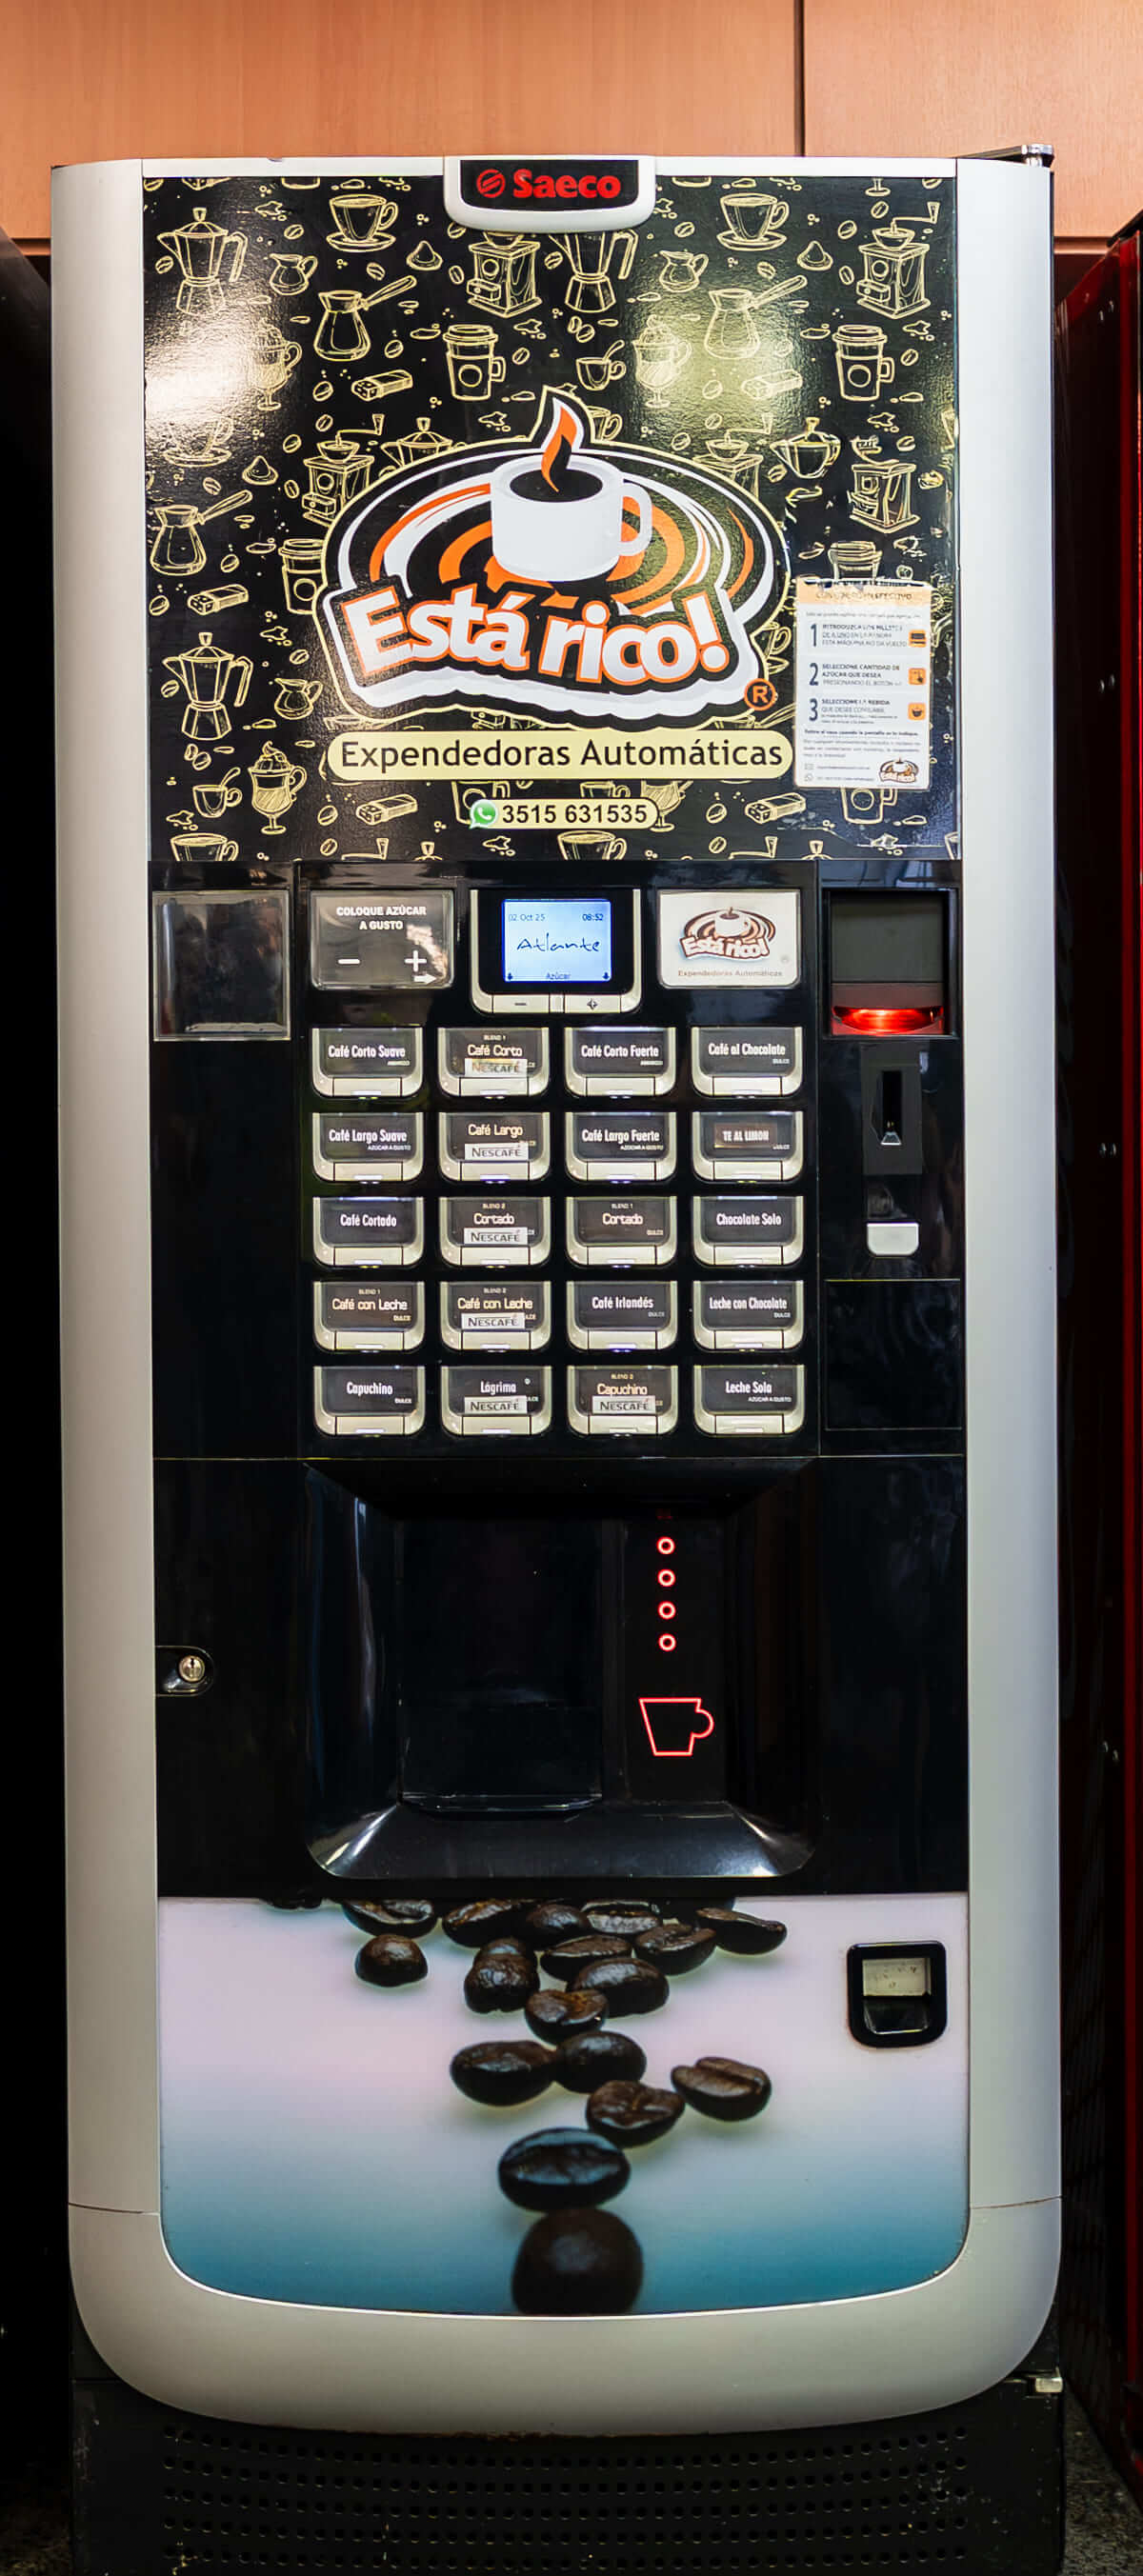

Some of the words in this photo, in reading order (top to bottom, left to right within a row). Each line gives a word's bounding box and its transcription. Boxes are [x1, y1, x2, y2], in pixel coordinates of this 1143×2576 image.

[513, 169, 621, 198] Saeco
[341, 583, 531, 677] Está
[538, 590, 730, 685] rico!
[811, 624, 817, 648] 1
[810, 662, 819, 686] 2
[809, 697, 818, 722] 3
[341, 739, 571, 772] Expendedoras
[581, 738, 782, 766] Automáticas
[502, 805, 557, 824] 3515
[564, 805, 648, 824] 631535
[335, 906, 384, 917] COLOQUE
[386, 904, 427, 917] AZÚCAR
[358, 920, 369, 930] A
[369, 920, 404, 930] GUSTO
[516, 931, 602, 952] Atlante
[328, 1044, 350, 1058] Café
[351, 1044, 377, 1058] Corto
[378, 1045, 406, 1058] Suave
[467, 1044, 490, 1056] Café
[492, 1044, 523, 1057] Corto
[581, 1044, 602, 1058] Café
[604, 1044, 629, 1058] Corto
[630, 1045, 659, 1058] Fuerte
[708, 1042, 729, 1056] Café
[731, 1043, 741, 1056] al
[742, 1043, 787, 1056] Chocolate
[329, 1128, 351, 1142] Café
[351, 1129, 378, 1145] Largo
[379, 1129, 408, 1143] Suave
[468, 1123, 491, 1136] Café
[493, 1124, 524, 1139] Largo
[581, 1128, 603, 1142] Café
[604, 1129, 630, 1145] Largo
[631, 1129, 660, 1142] Fuerte
[722, 1130, 732, 1142] TE
[733, 1130, 744, 1142] AL
[340, 1213, 360, 1228] Café
[362, 1213, 397, 1228] Cortado
[473, 1212, 515, 1226] Cortado
[602, 1212, 644, 1226] Cortado
[716, 1212, 760, 1227] Chocolate
[761, 1212, 782, 1227] Solo
[331, 1298, 355, 1310] Café
[357, 1300, 376, 1310] con
[378, 1298, 409, 1310] Leche
[457, 1297, 481, 1309] Café
[483, 1299, 502, 1309] con
[504, 1297, 533, 1309] Leche
[592, 1296, 613, 1309] Café
[615, 1296, 654, 1309] Irlandés
[709, 1296, 732, 1309] Leche
[732, 1299, 748, 1309] con
[749, 1296, 788, 1309] Chocolate
[346, 1381, 393, 1397] Capuchino
[480, 1380, 517, 1396] Lágrima
[596, 1383, 648, 1397] Capuchino
[725, 1381, 750, 1394] Leche
[752, 1381, 772, 1394] Sola
